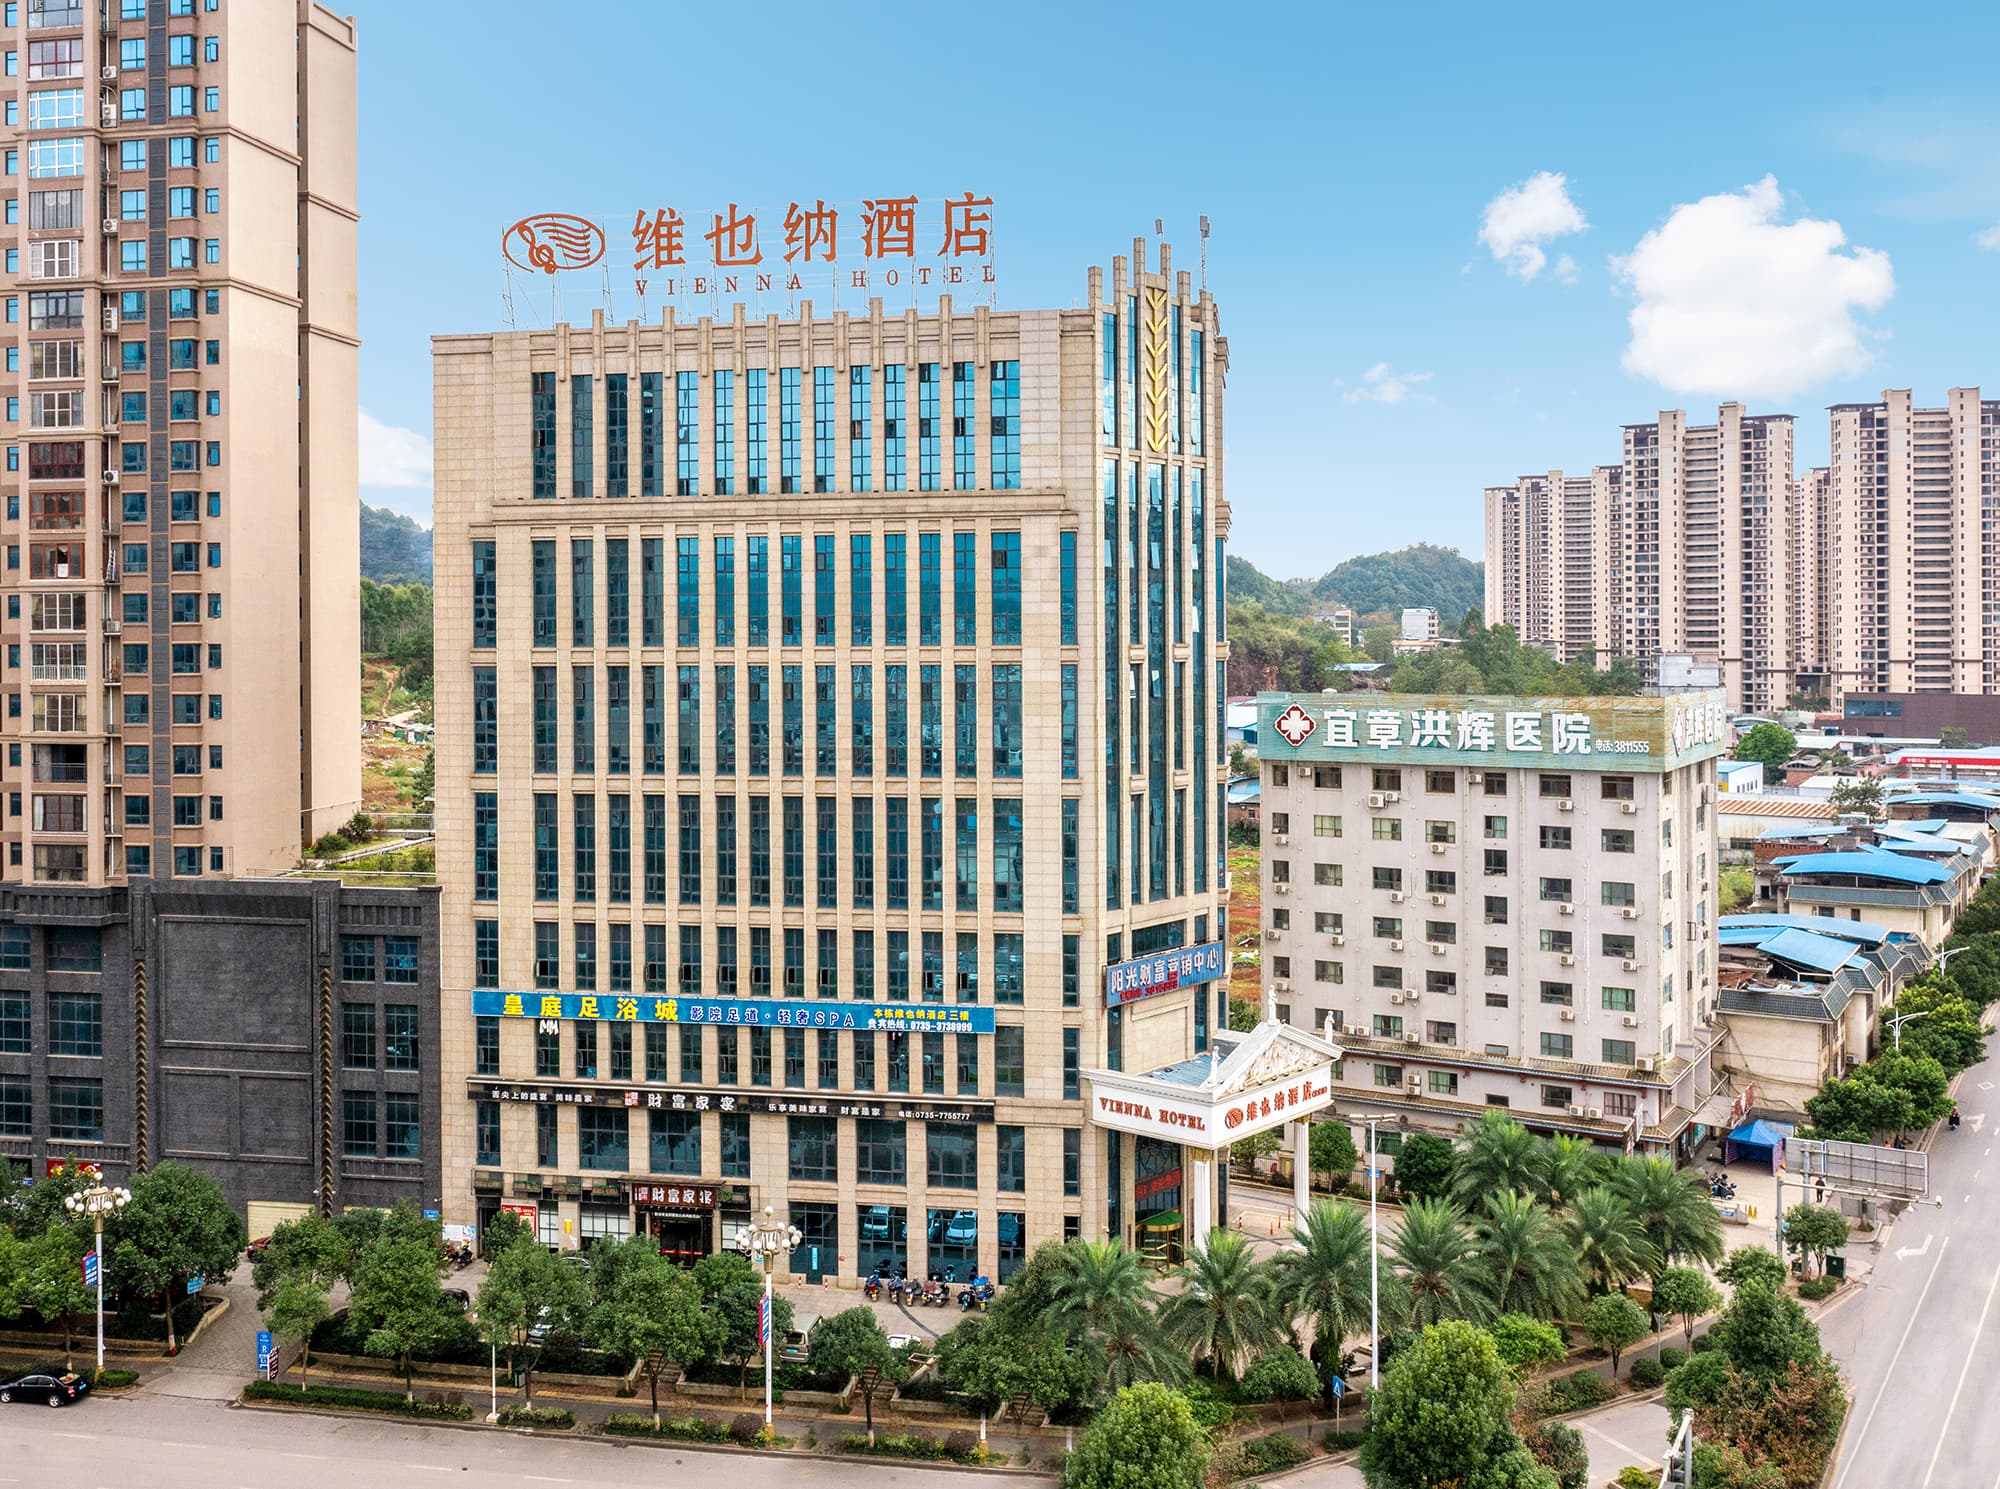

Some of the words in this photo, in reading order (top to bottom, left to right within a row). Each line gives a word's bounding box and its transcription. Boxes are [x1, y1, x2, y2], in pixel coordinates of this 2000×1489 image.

[632, 191, 994, 271] 维也纳酒店
[635, 273, 803, 297] VIENNA
[852, 265, 996, 287] HOTEL
[1322, 708, 1592, 755] 宜章洪辉医院
[1111, 947, 1219, 994] 阳光财富营销中心
[503, 994, 679, 1021] 皇庭足浴城
[1099, 1096, 1153, 1120] VIENNA
[1158, 1108, 1206, 1131] HOTEL
[1246, 1081, 1312, 1121] 维也纳酒店
